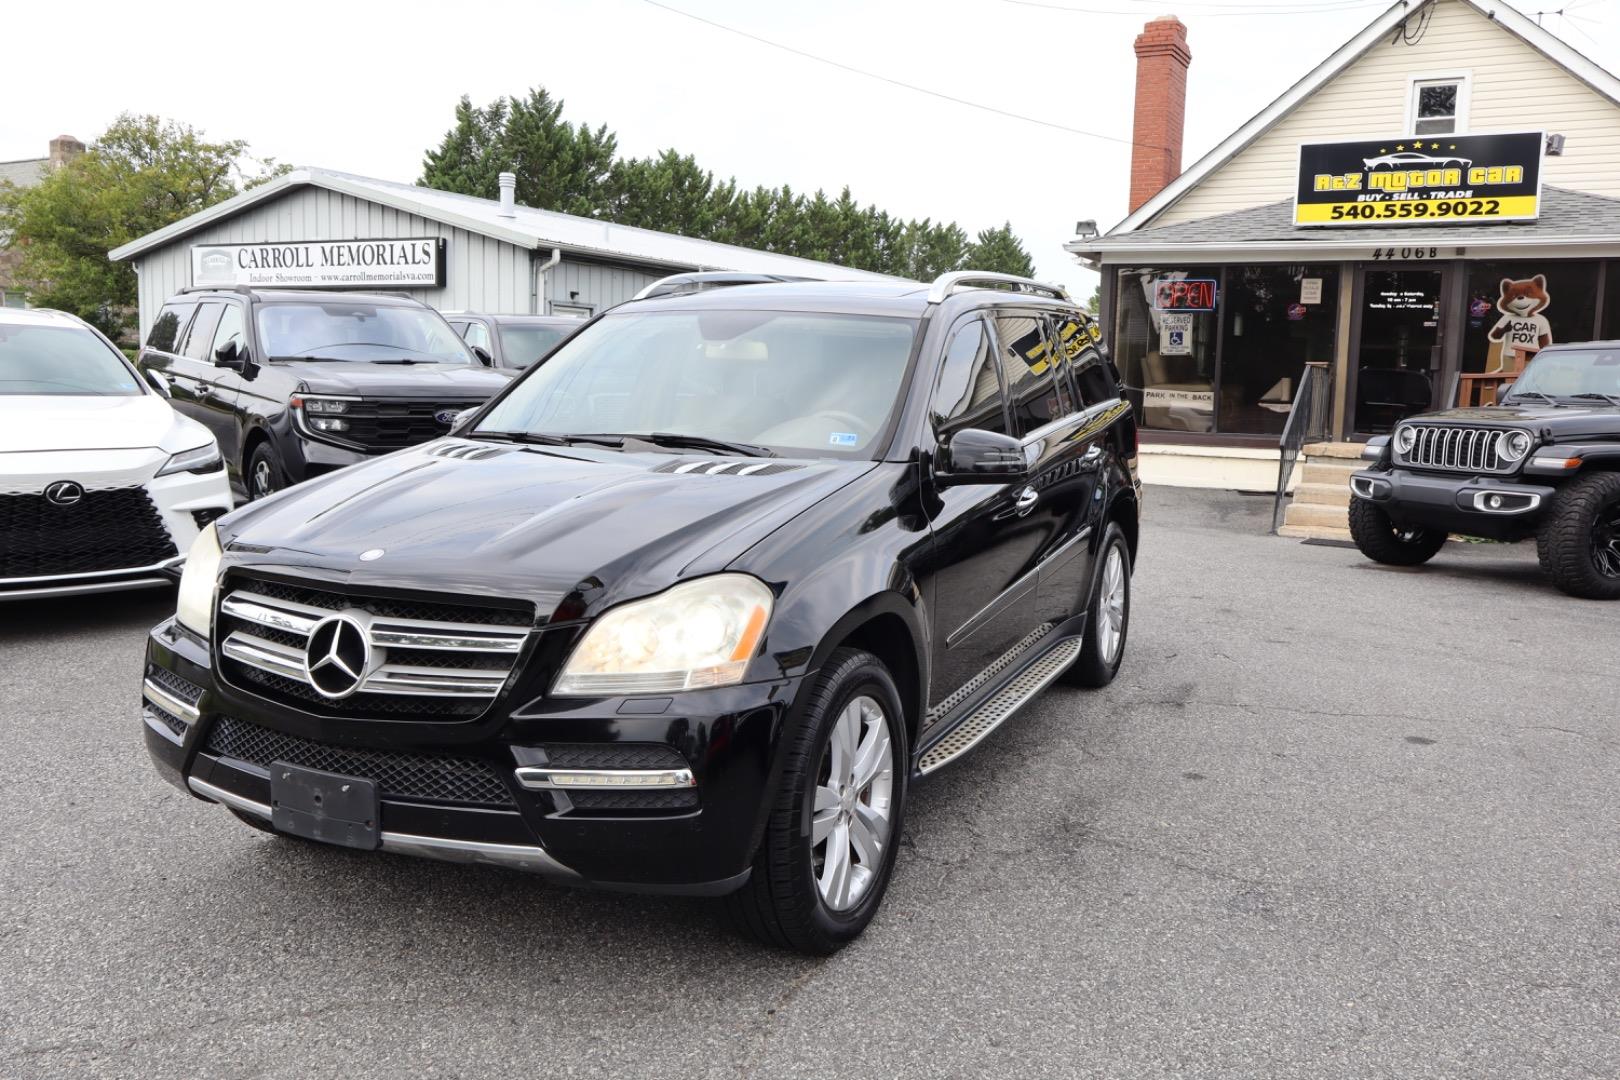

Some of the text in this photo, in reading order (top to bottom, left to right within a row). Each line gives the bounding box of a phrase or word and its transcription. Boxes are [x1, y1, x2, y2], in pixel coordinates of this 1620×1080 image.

[1357, 190, 1474, 202] BUY SELL TRADE
[1330, 200, 1500, 220] 540.559.9022
[238, 242, 431, 269] CARROLL MEMORIALS
[249, 273, 273, 282] Indoor
[275, 272, 312, 282] Showroom
[321, 271, 434, 282] www.carrollmemorialsva.com
[1159, 282, 1214, 307] OPEN
[1513, 323, 1537, 333] CAR
[1512, 334, 1535, 343] FOX
[1146, 391, 1166, 399] PARK
